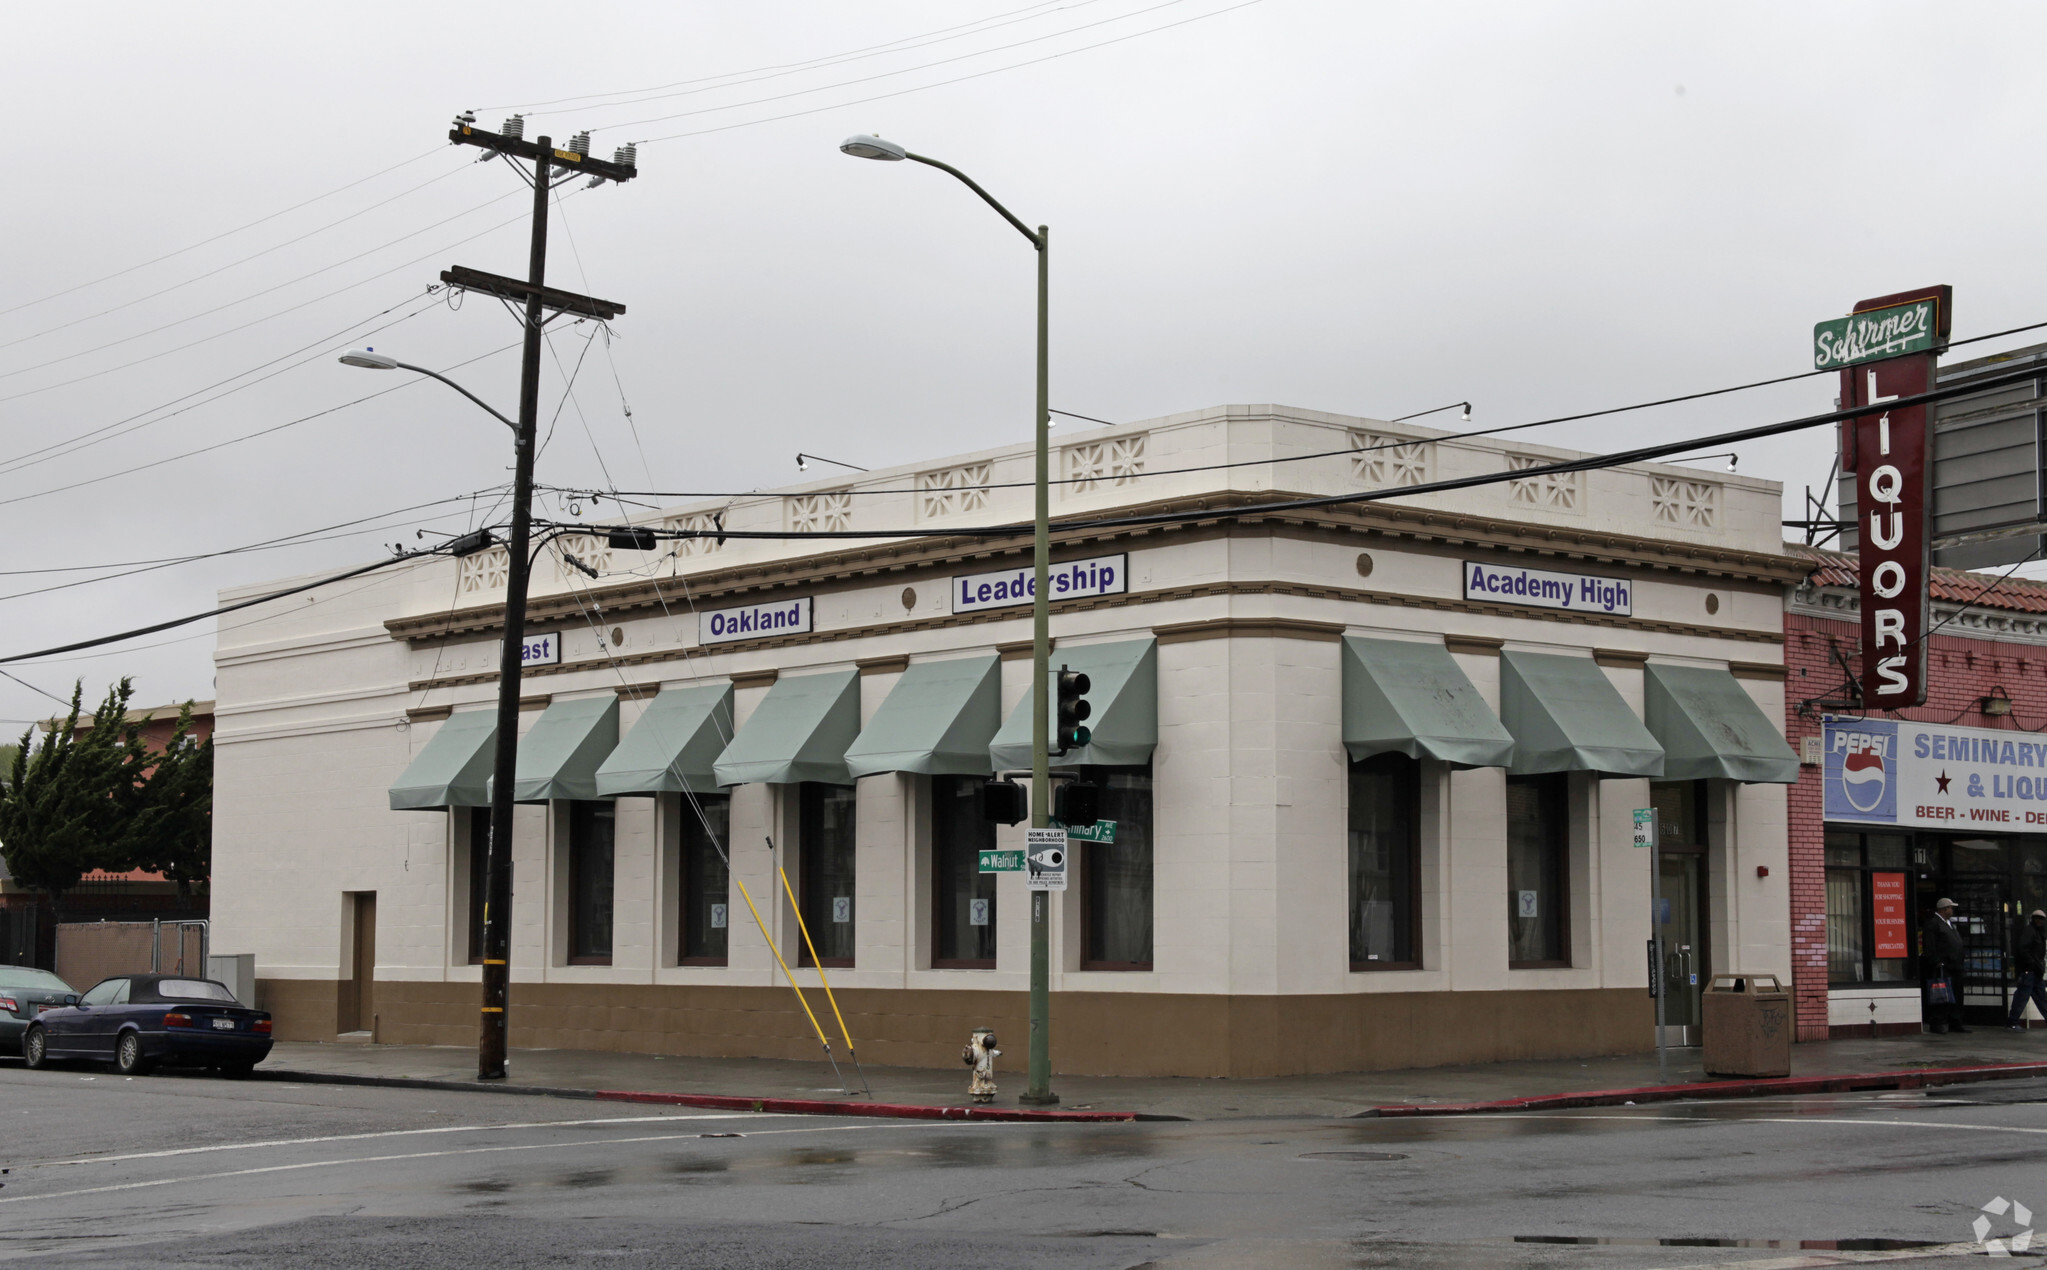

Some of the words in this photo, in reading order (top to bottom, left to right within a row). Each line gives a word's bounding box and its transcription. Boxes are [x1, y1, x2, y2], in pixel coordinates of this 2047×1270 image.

[1867, 369, 1908, 695] LIQUORS
[962, 562, 1114, 604] Leadership
[1470, 566, 1573, 606] Academy
[1581, 578, 1628, 611] High
[711, 603, 800, 636] Oakland
[522, 638, 549, 660] ast
[1833, 731, 1892, 757] PEPSI
[1914, 733, 2047, 768] SEMINARY
[1967, 773, 1986, 798] &
[1634, 822, 1643, 831] 45
[1916, 805, 1955, 820] BEER
[1970, 808, 2010, 822] WINE
[2025, 811, 2047, 825] DE
[1634, 835, 1646, 843] 650
[990, 854, 1019, 868] Walnut
